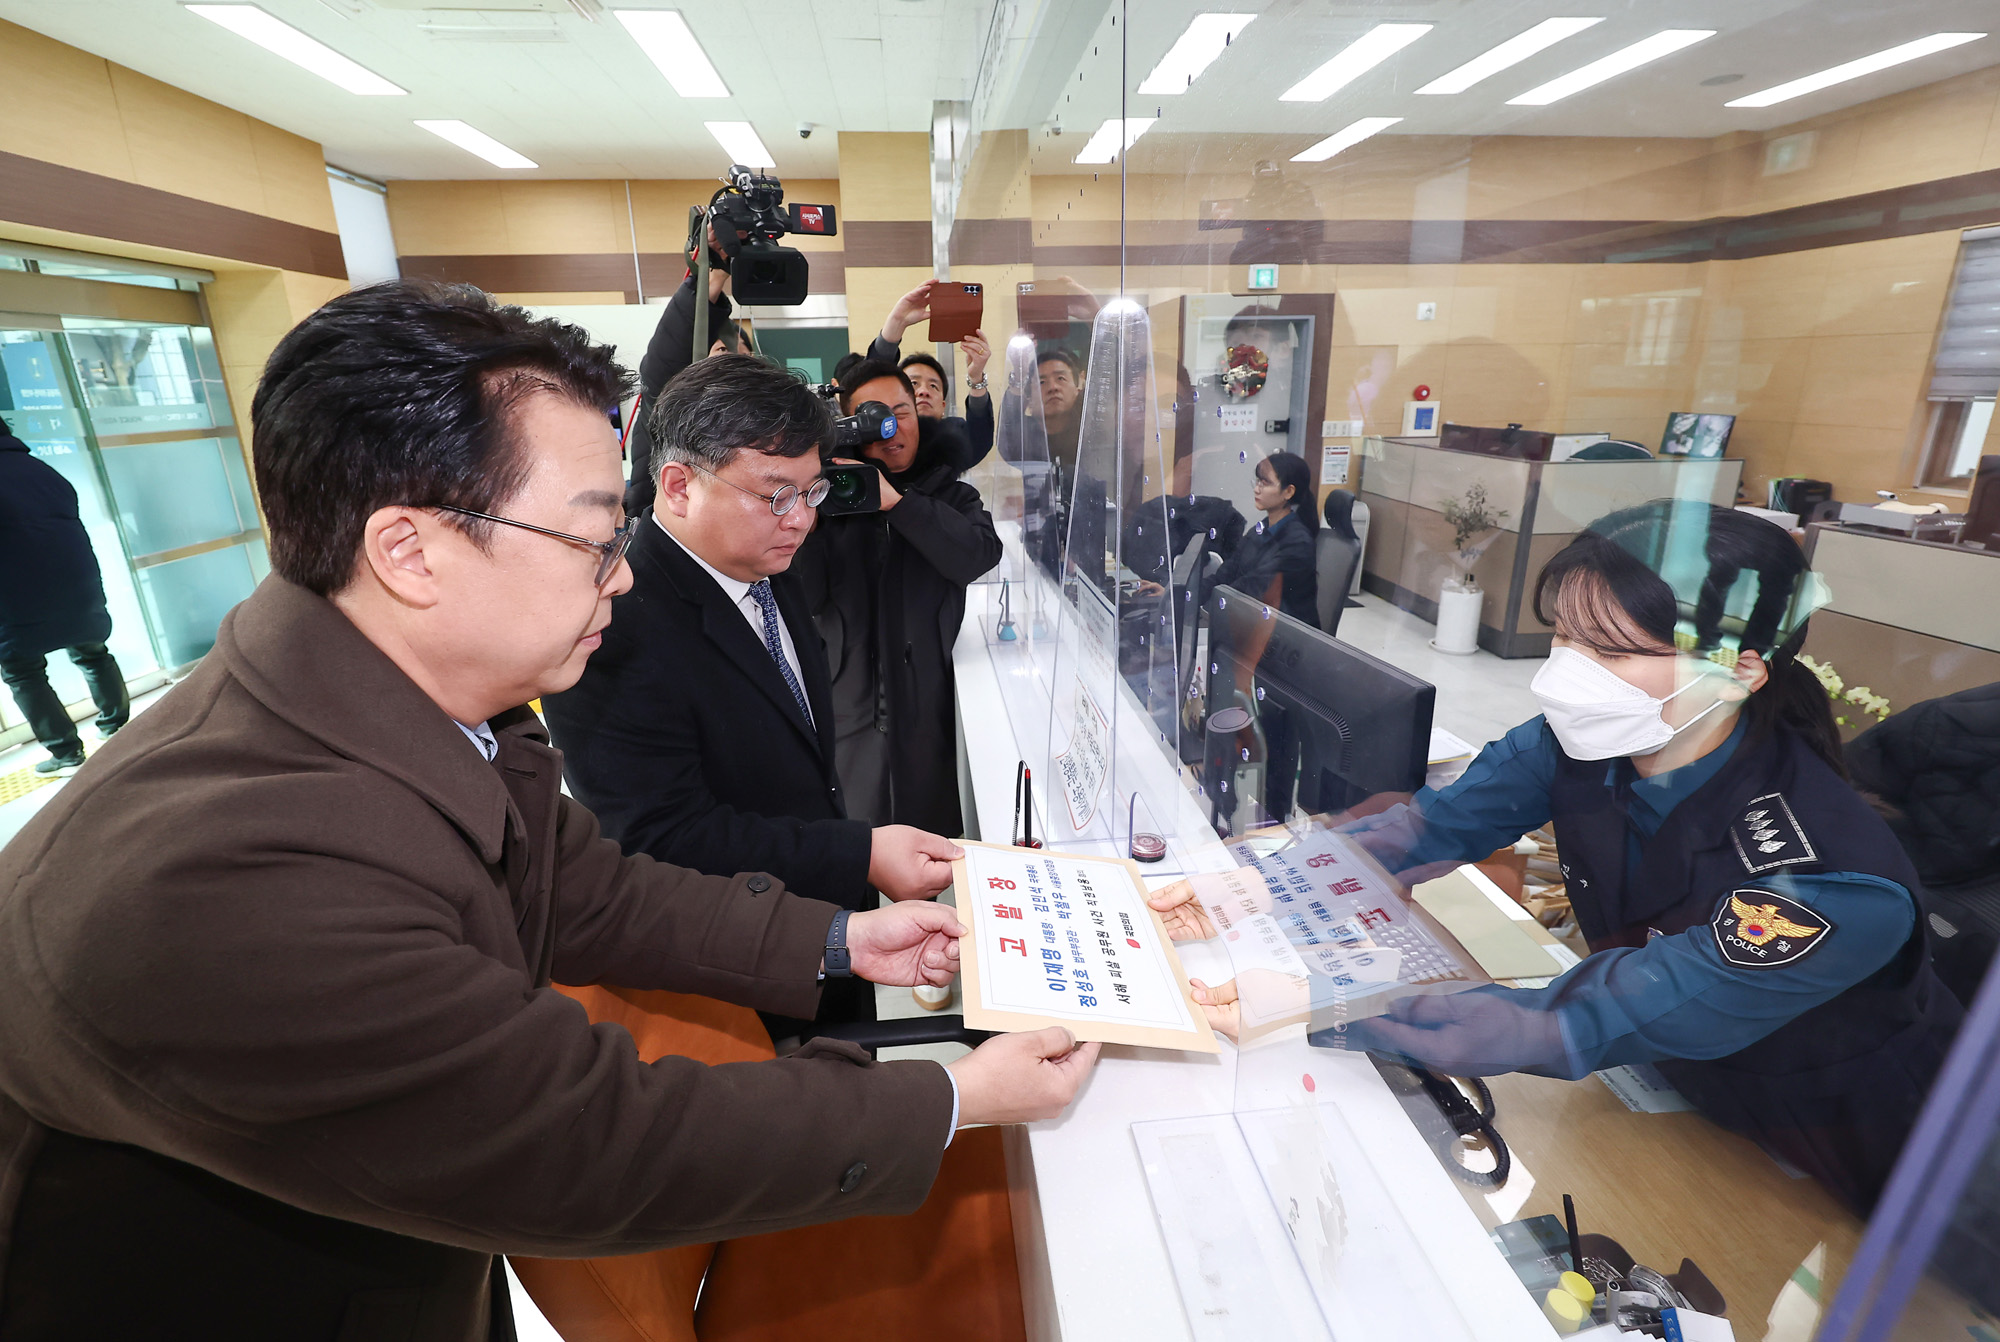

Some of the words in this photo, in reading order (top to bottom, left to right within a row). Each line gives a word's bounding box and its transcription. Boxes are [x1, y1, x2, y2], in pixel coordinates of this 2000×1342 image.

[1028, 886, 1050, 912] 김민석
[1052, 892, 1072, 919] 박철우
[1089, 910, 1105, 927] 사건
[1119, 912, 1134, 937] 국민의힘
[1096, 930, 1116, 956] 공무원
[1725, 934, 1768, 958] POLICE
[1040, 948, 1067, 992] 이재명
[1105, 961, 1122, 978] 피살
[1072, 969, 1097, 1007] 정성호
[1113, 983, 1130, 1004] 서해
